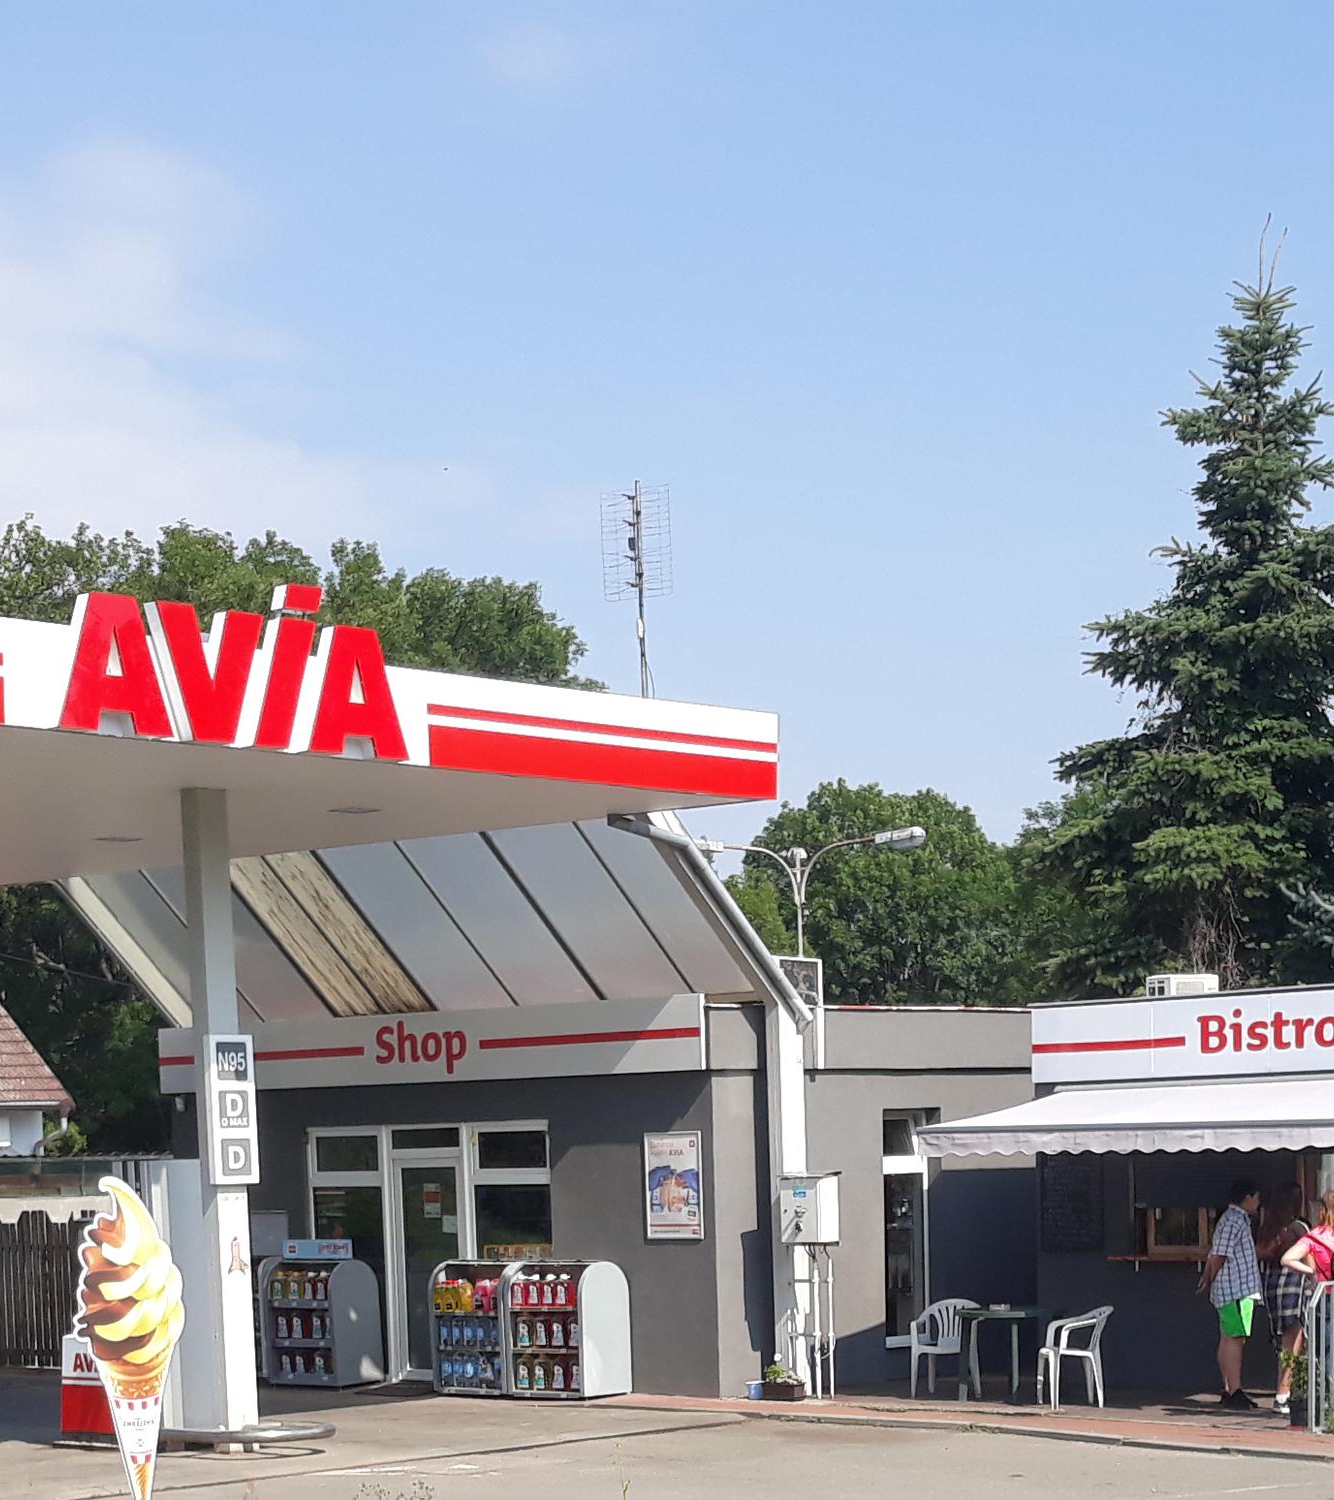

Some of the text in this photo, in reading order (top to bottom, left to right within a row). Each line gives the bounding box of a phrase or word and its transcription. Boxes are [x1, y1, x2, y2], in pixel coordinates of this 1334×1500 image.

[375, 1020, 467, 1074] Shop
[217, 1051, 247, 1072] N95
[225, 1092, 244, 1117] D
[227, 1145, 246, 1170] D
